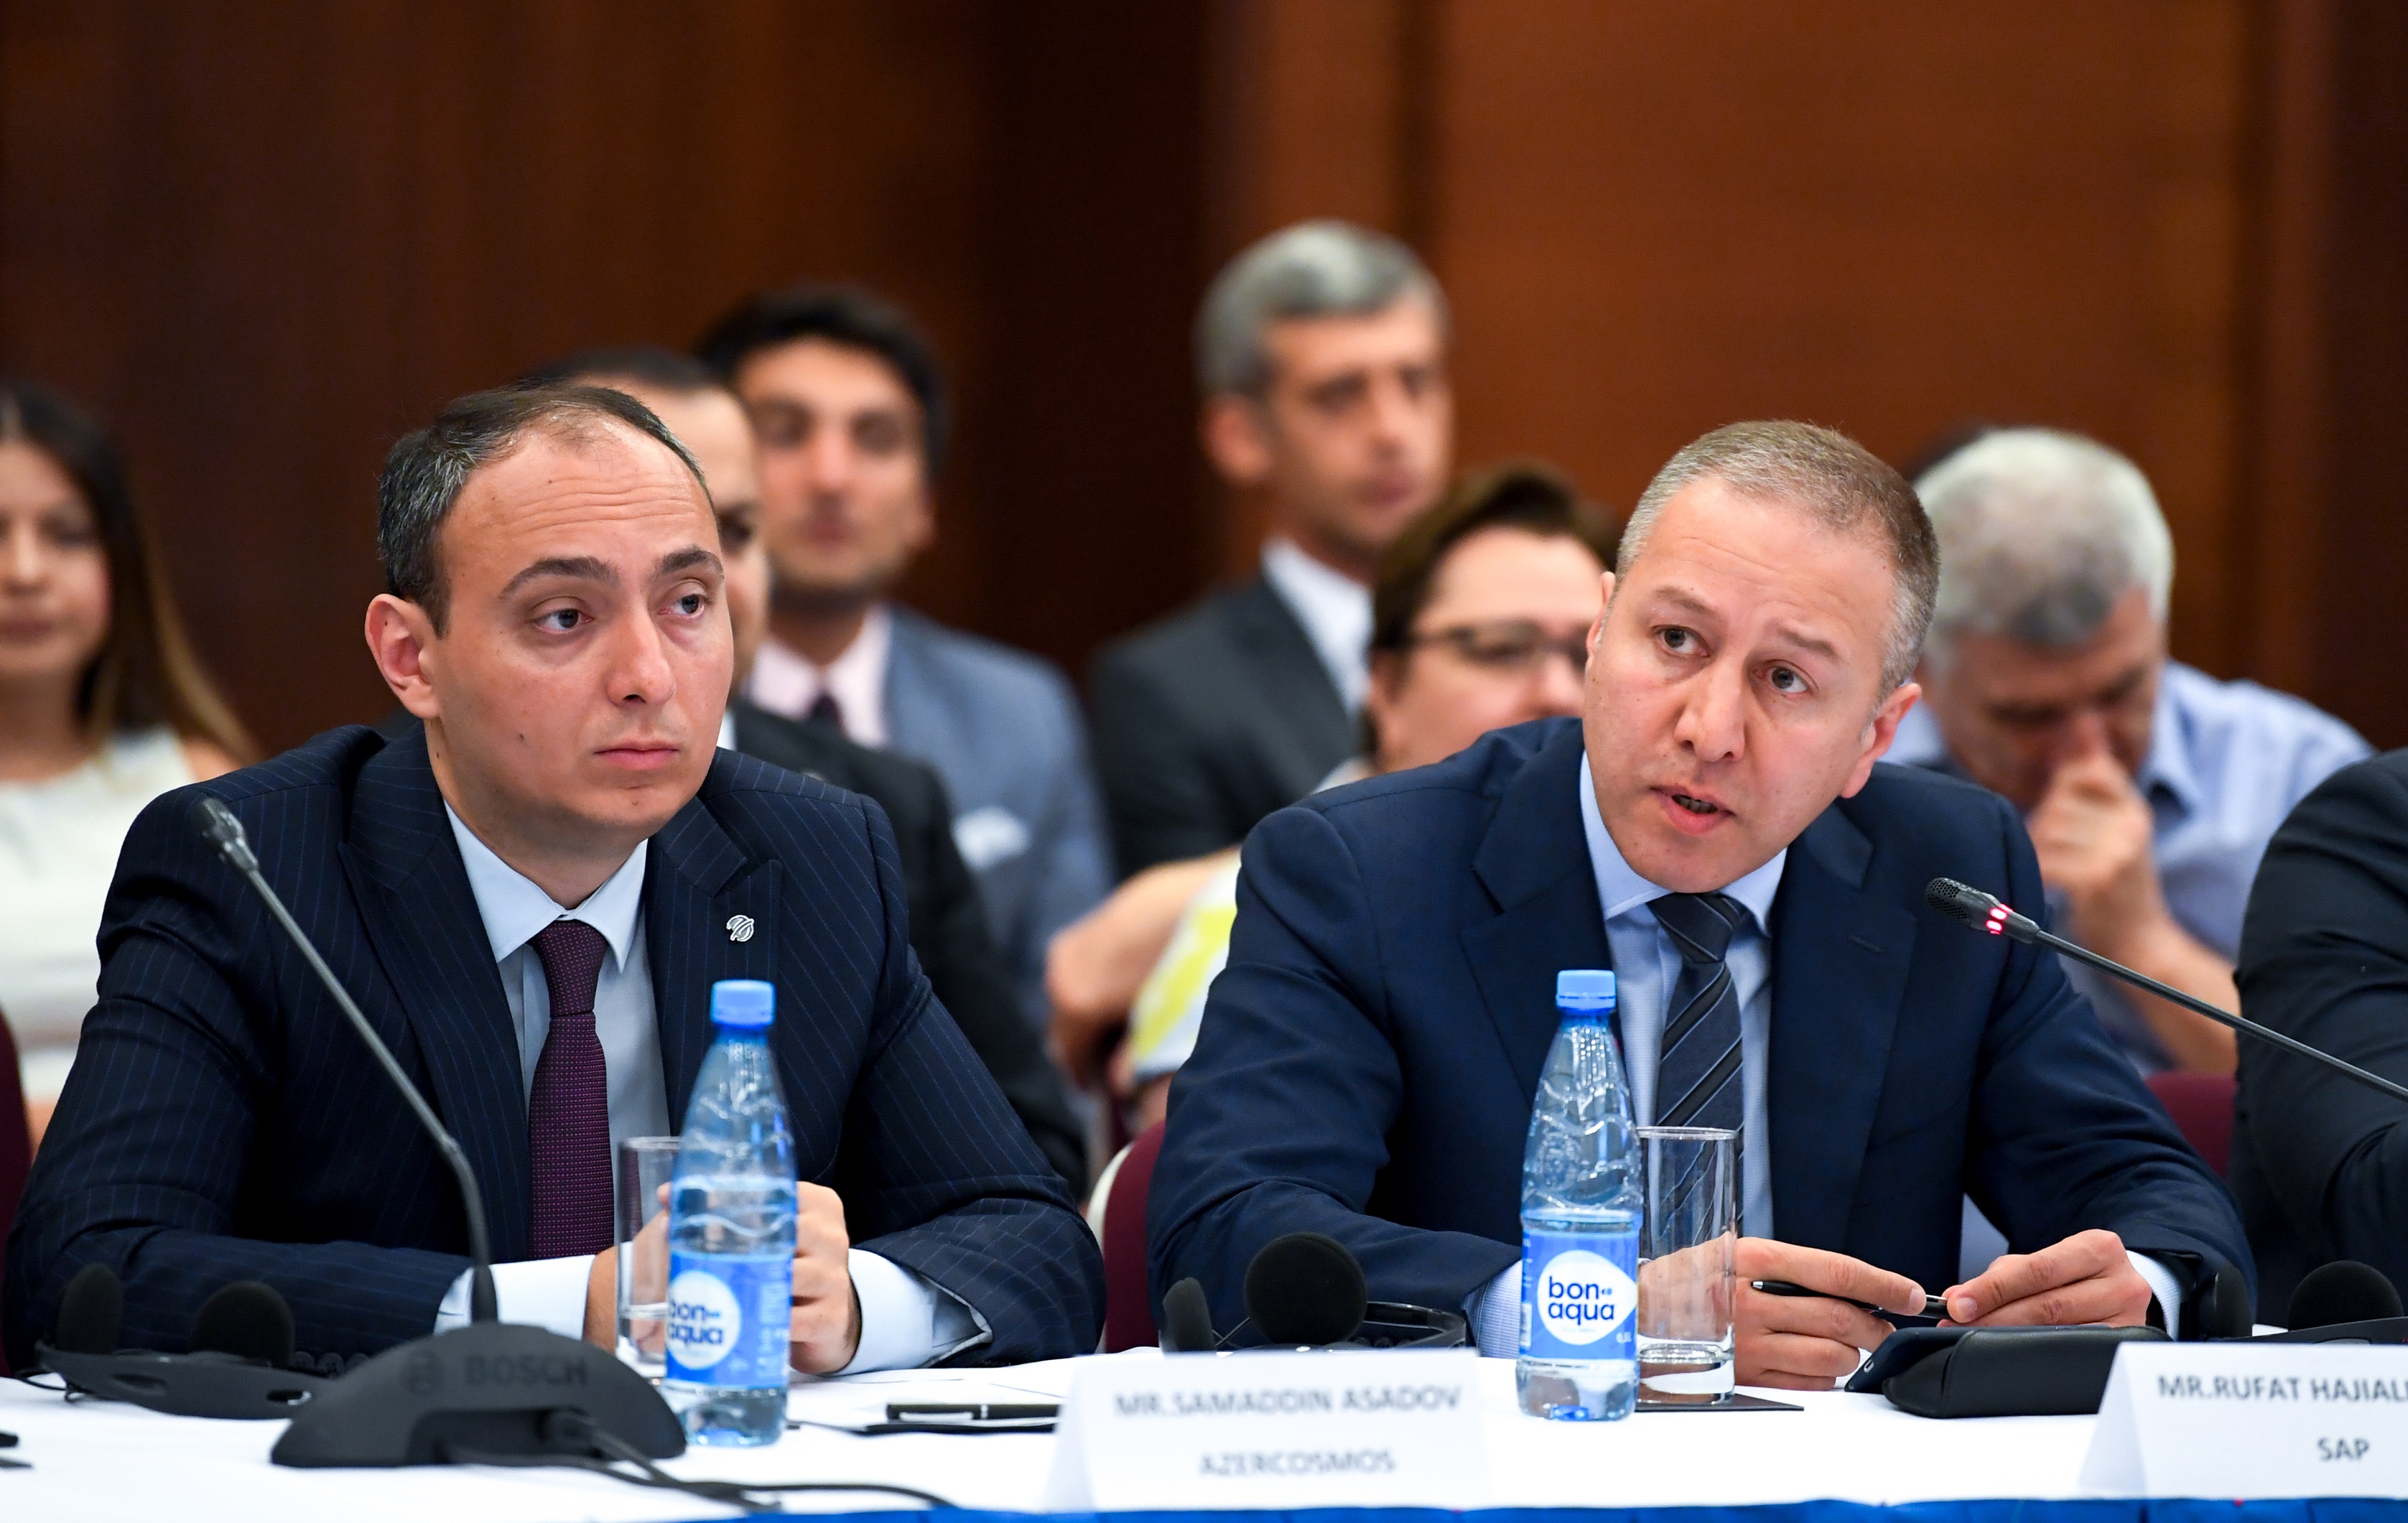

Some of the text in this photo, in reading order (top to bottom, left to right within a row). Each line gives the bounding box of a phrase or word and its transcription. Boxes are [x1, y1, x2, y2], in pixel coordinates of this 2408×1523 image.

[1548, 1275, 1600, 1300] bon
[1548, 1302, 1615, 1326] aqua
[1342, 1386, 1461, 1412] ASADOV
[2317, 1436, 2370, 1462] SAP
[1200, 1449, 1397, 1477] AZERCOSMOS
